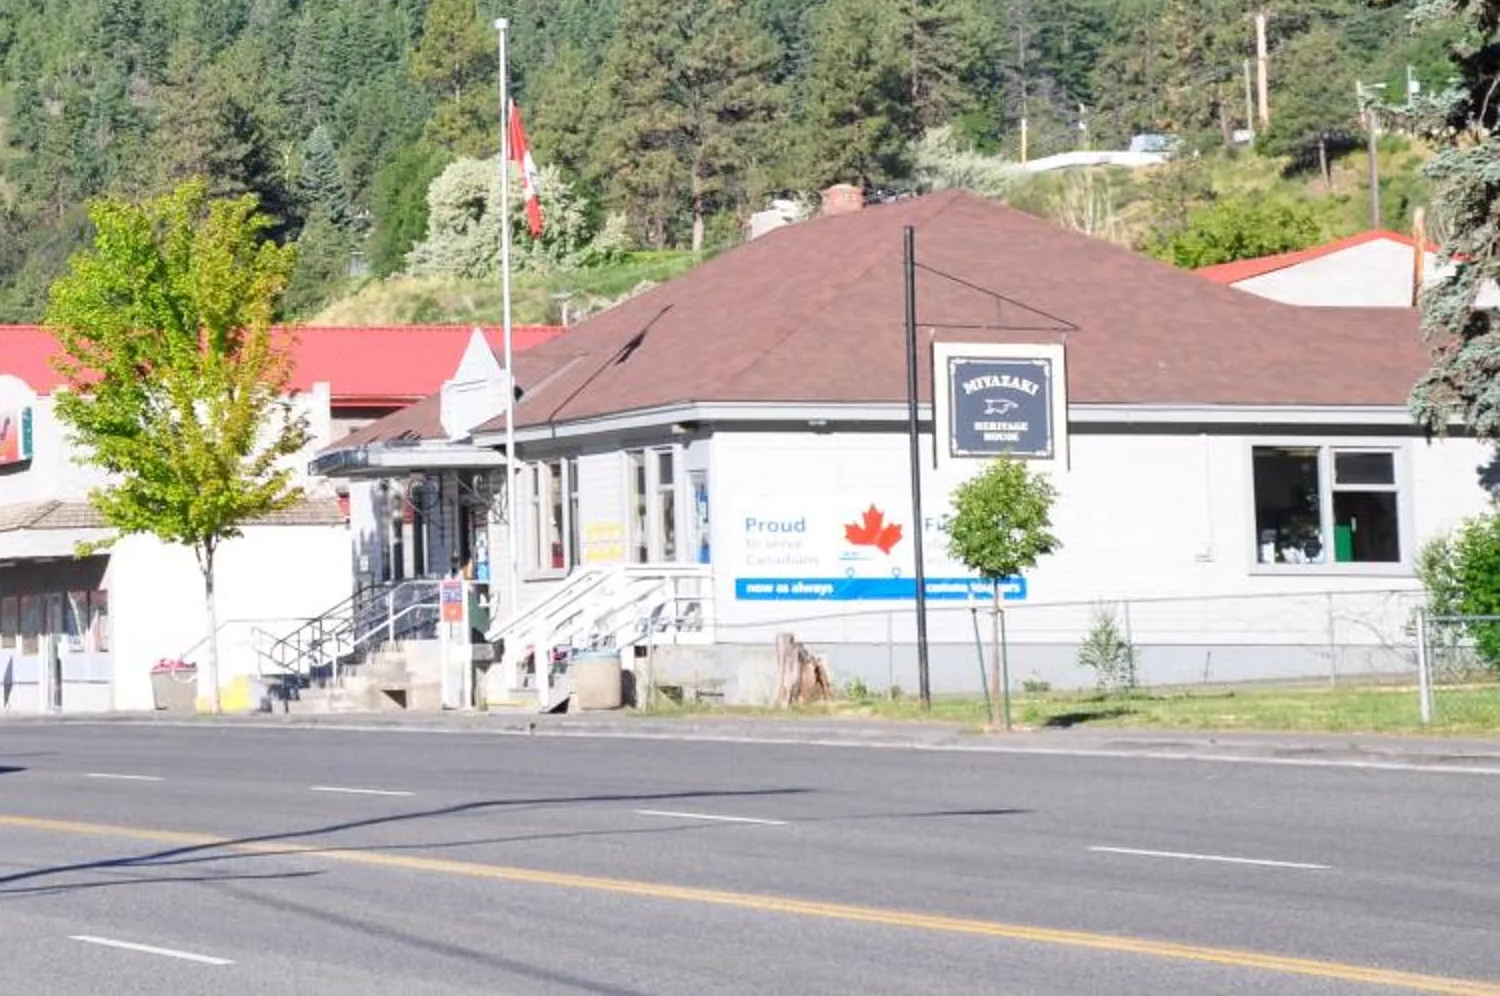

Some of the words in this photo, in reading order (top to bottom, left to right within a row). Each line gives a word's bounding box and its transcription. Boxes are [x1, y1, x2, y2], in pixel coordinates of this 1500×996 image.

[962, 375, 1040, 396] MIYAZAKI
[973, 421, 1029, 431] HERITAGE
[745, 516, 806, 533] Proud
